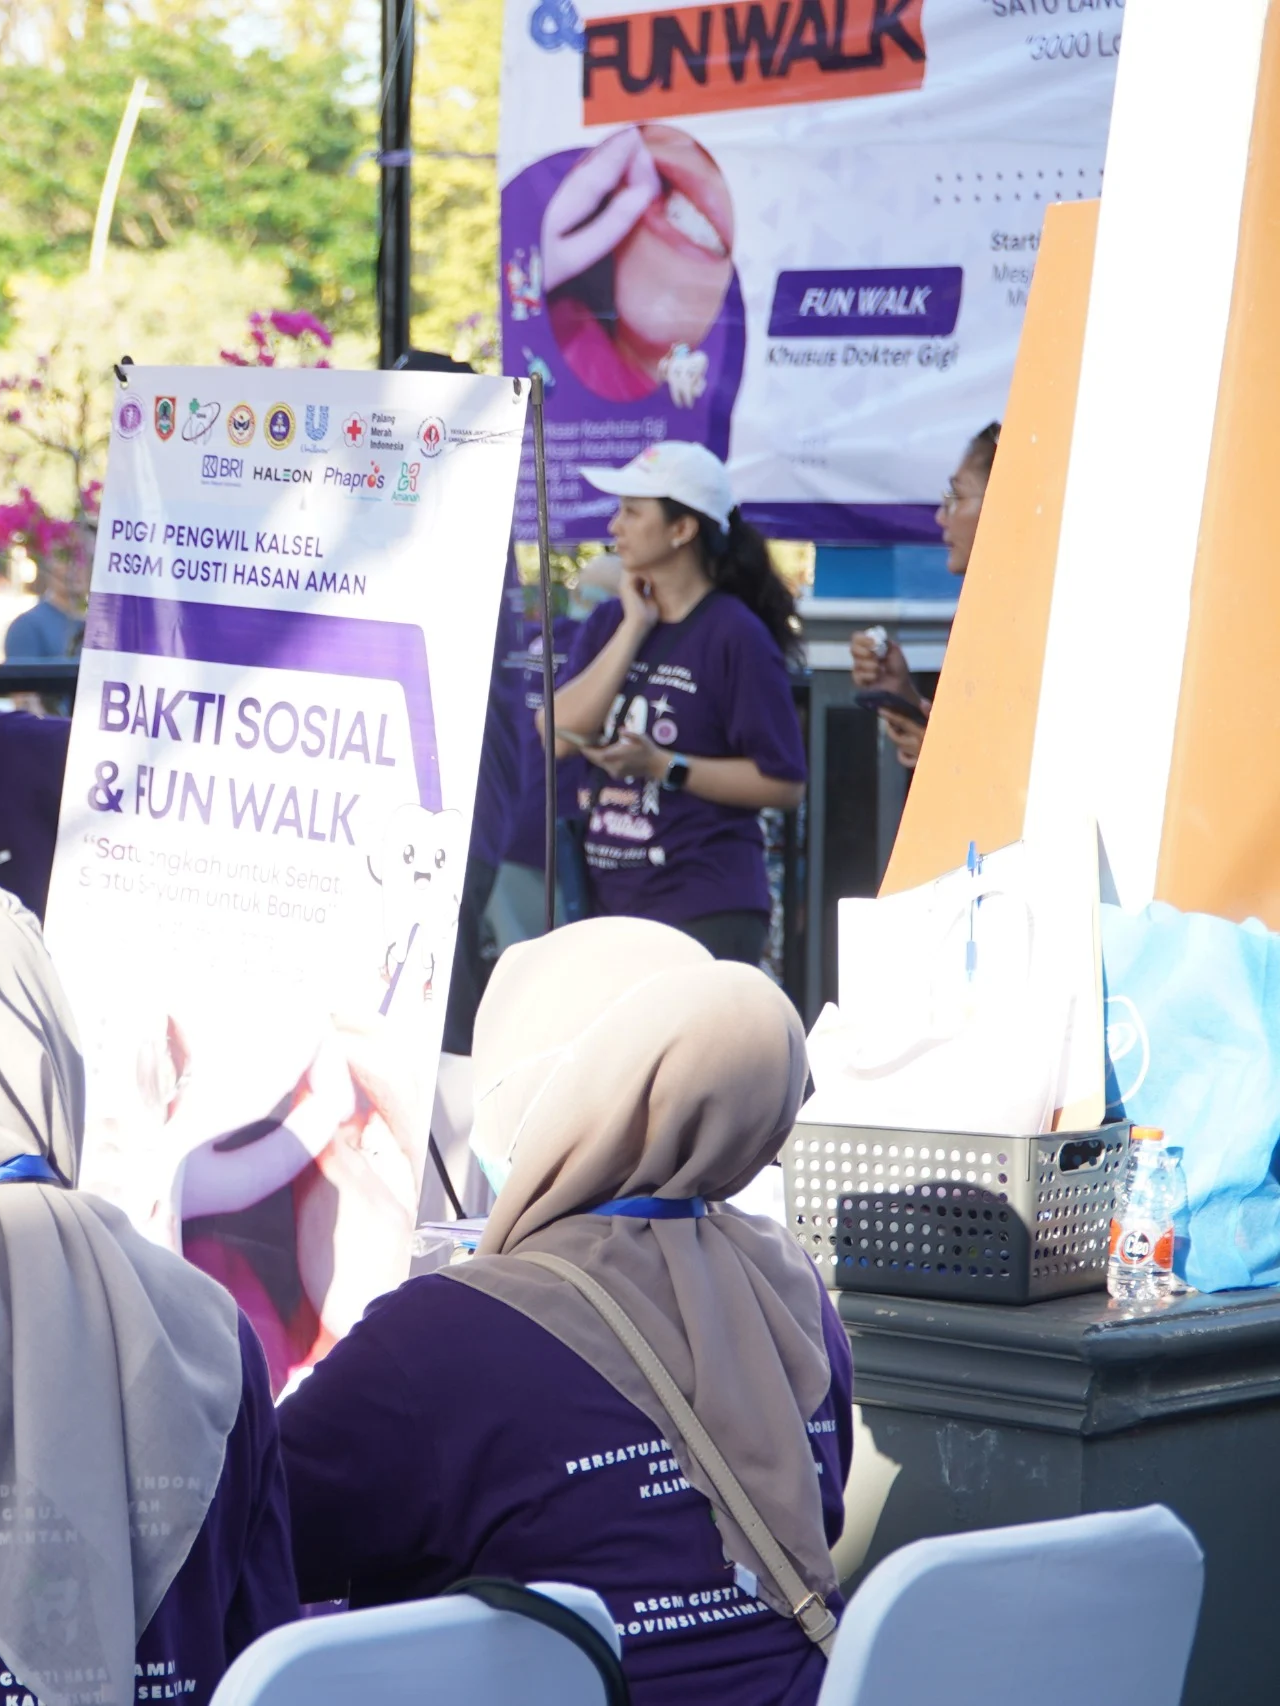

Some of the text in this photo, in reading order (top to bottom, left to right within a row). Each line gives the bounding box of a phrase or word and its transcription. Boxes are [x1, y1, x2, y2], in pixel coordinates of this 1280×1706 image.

[583, 10, 712, 100] FUN
[724, 0, 927, 82] WALK
[799, 286, 931, 316] FUN WALK
[766, 344, 837, 367] Khusus
[842, 341, 911, 367] Dokter
[371, 427, 392, 437] Merah
[372, 413, 396, 426] Palang
[370, 440, 404, 451] Indonesia
[220, 457, 244, 479] BRI
[253, 465, 313, 483] HALEON
[323, 466, 385, 493] Phapros
[111, 520, 324, 558] PDGI PENGWIL KALSEL
[108, 552, 367, 596] RSGM GUSTI HASAN AMAN
[98, 680, 397, 768] BAKTI SOSIAL
[87, 760, 361, 847] & FUN WALK
[227, 861, 280, 885] untuk
[206, 890, 260, 914] untuk
[566, 1438, 672, 1476] PERSATUAN
[633, 1587, 739, 1613] RSGM GUSTI
